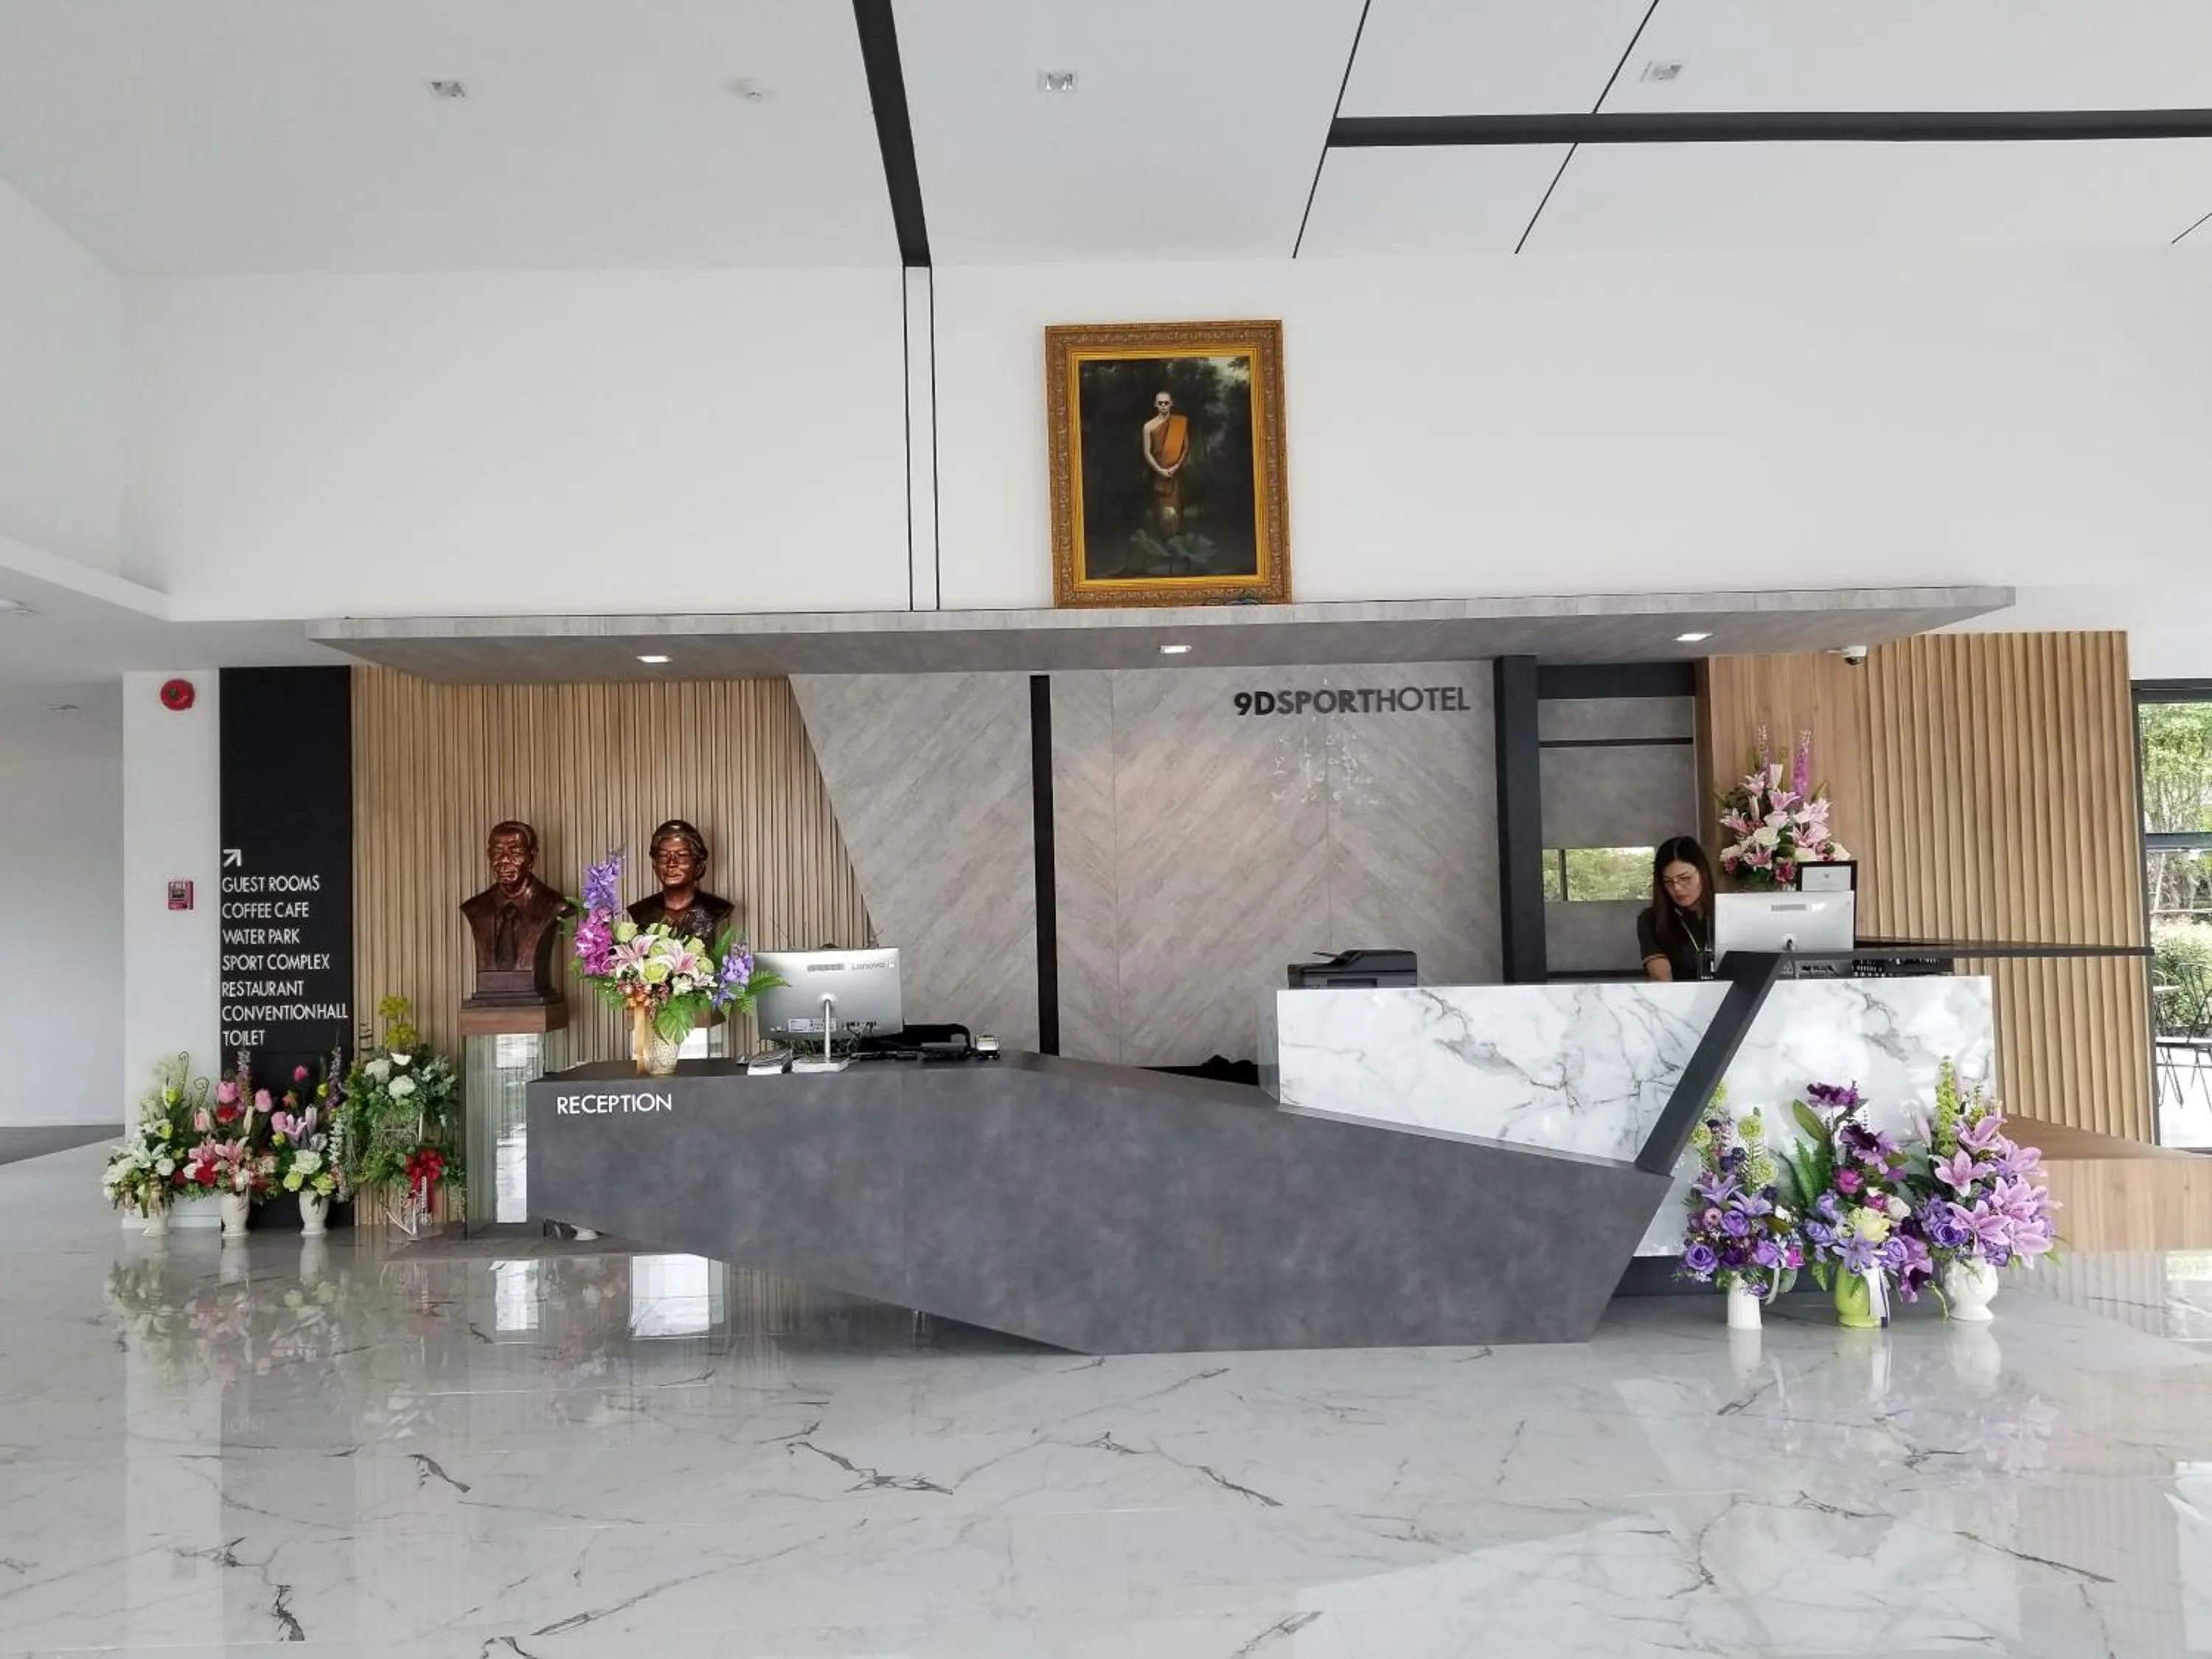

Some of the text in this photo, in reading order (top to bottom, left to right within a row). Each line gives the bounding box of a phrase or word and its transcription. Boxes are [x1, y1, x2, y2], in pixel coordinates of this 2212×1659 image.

[222, 875, 320, 893] GUEST ROOMS
[222, 902, 309, 919] COFFEE CAFE
[223, 928, 300, 945] WATER PARK
[222, 953, 330, 971] SPORT COMPLEX
[222, 981, 305, 997] RESTAURANT
[223, 1030, 265, 1047] TOILET
[557, 1093, 672, 1115] RECEPTION
